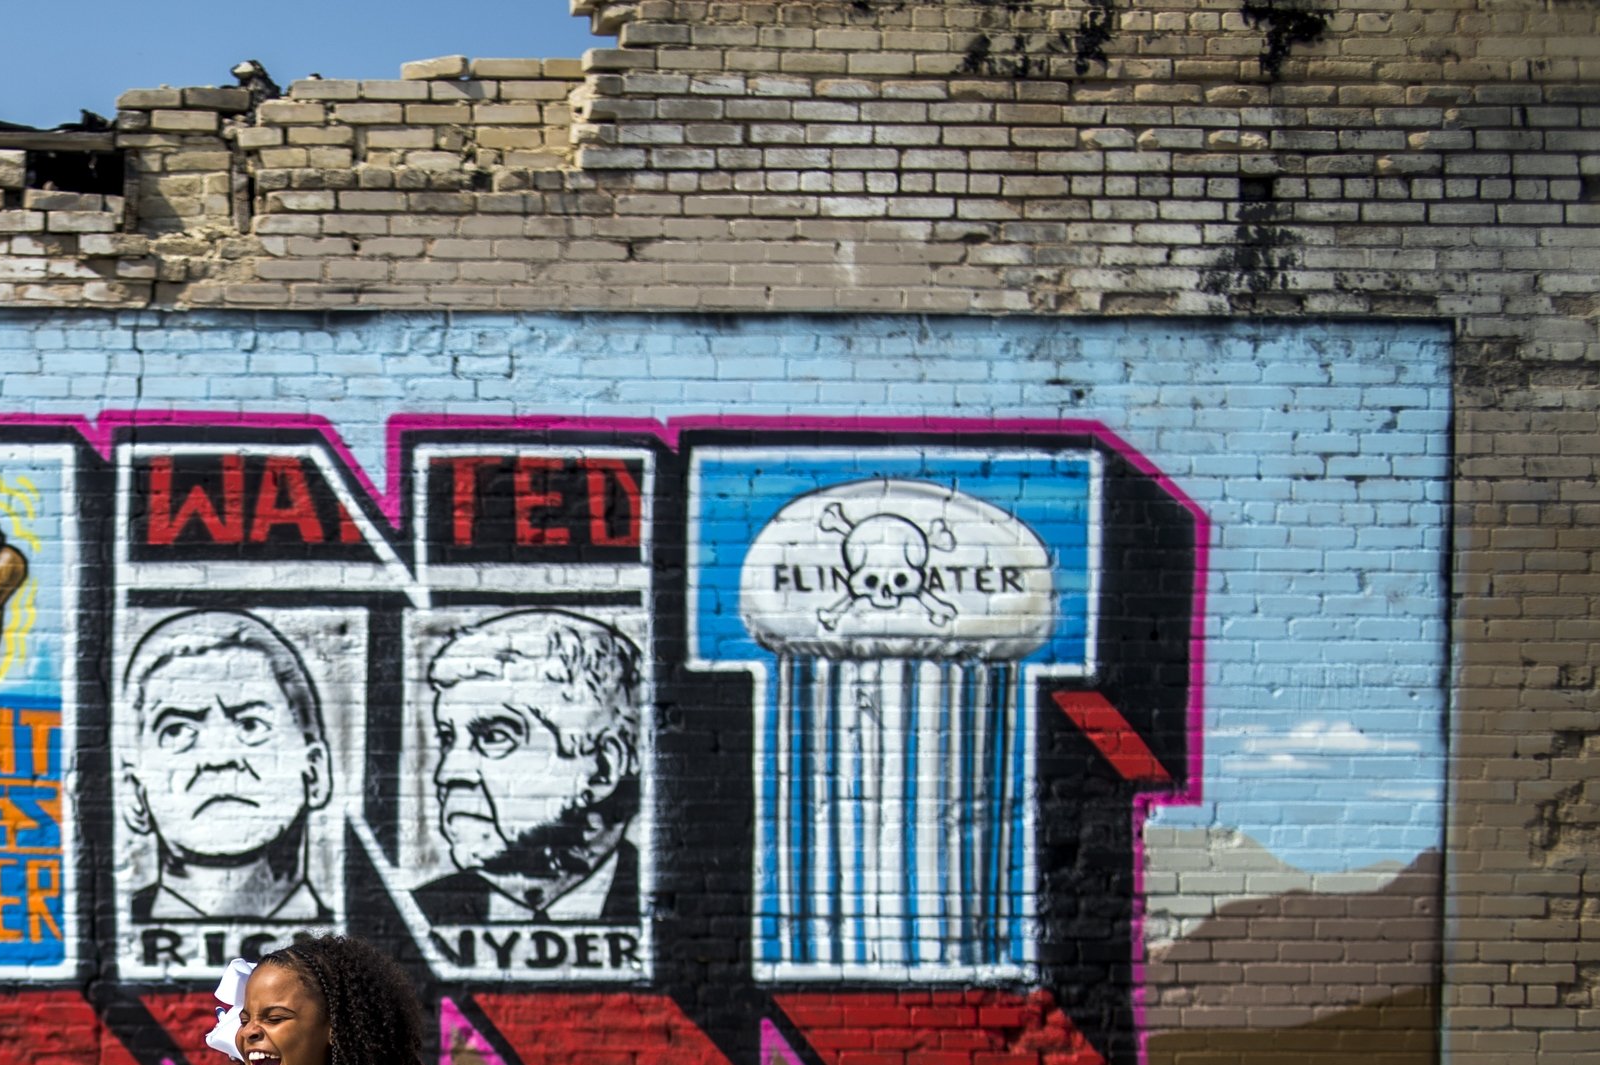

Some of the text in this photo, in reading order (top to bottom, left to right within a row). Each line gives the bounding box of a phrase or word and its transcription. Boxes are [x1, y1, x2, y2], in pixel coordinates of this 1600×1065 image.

[146, 455, 643, 546] WATED
[773, 564, 1024, 594] FLIN ATER
[141, 928, 310, 967] RIC
